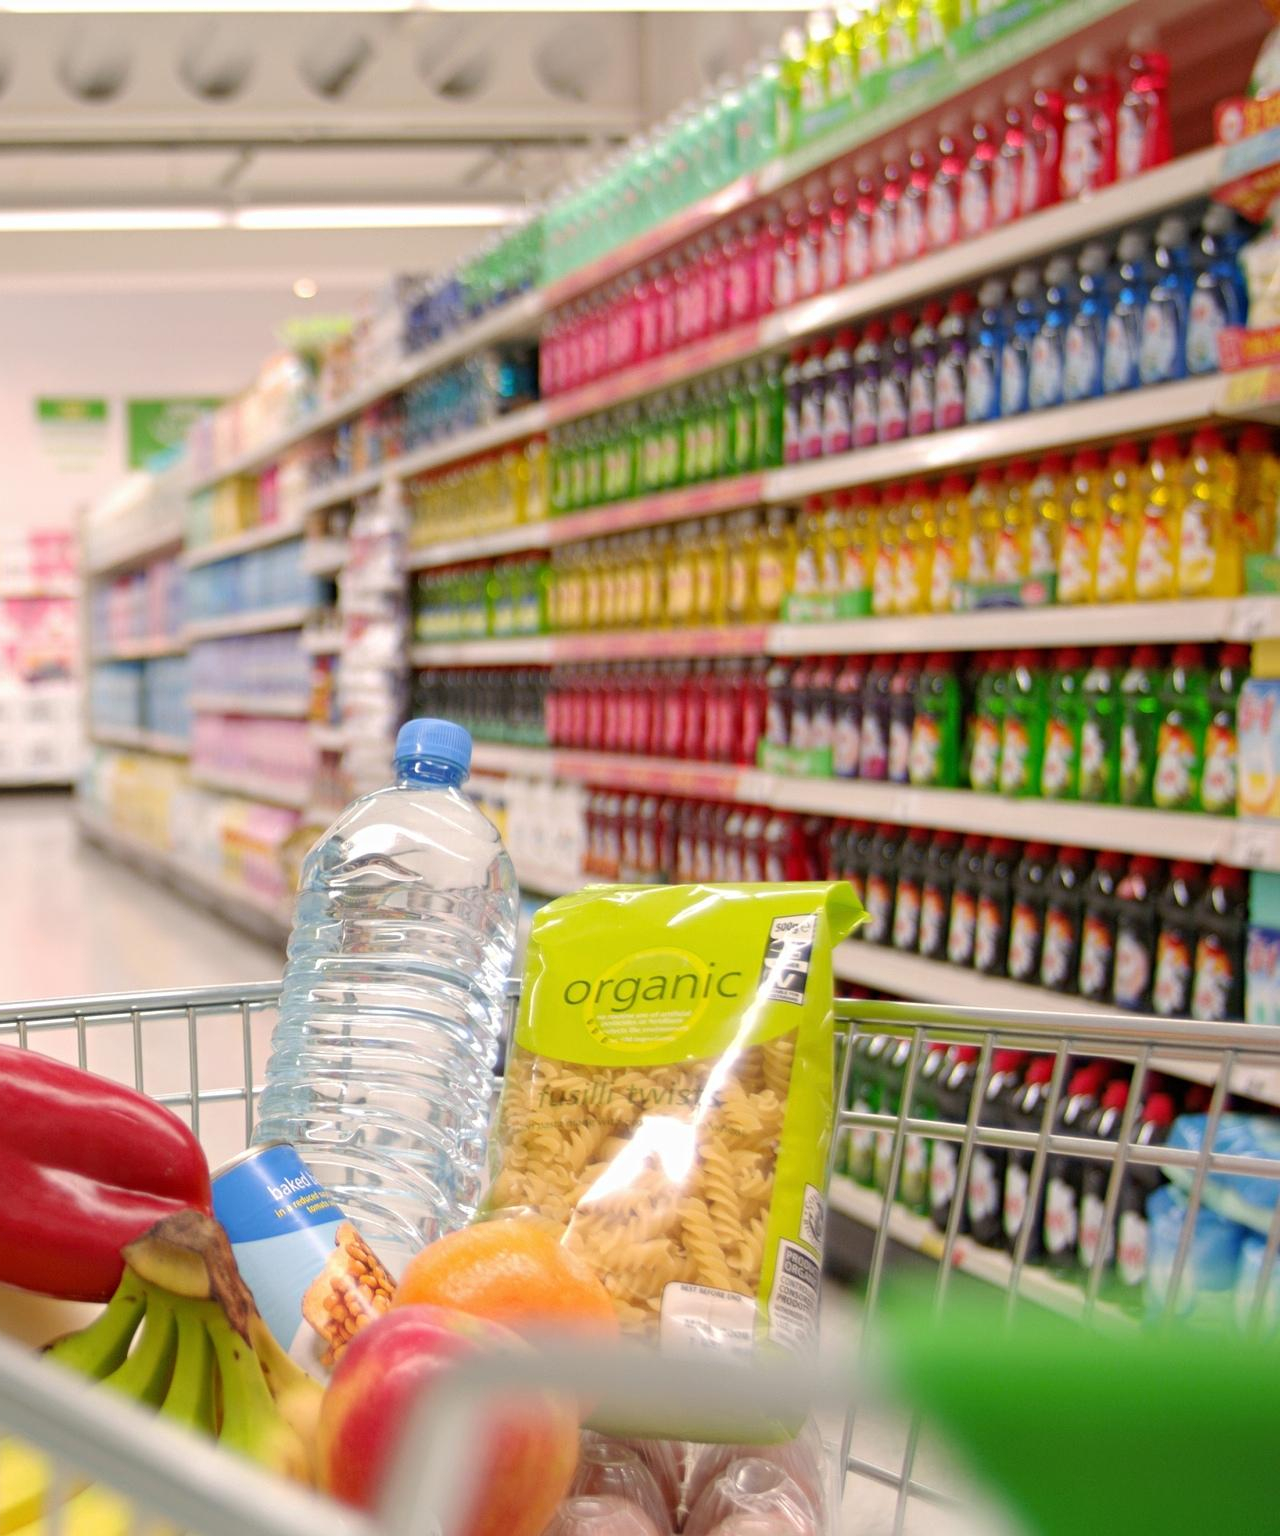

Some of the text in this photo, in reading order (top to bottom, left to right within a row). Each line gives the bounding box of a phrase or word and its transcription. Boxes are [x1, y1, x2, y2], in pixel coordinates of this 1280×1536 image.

[563, 962, 742, 1012] organic
[537, 1081, 614, 1109] fusilli
[266, 1170, 312, 1201] baked
[274, 1208, 287, 1218] in
